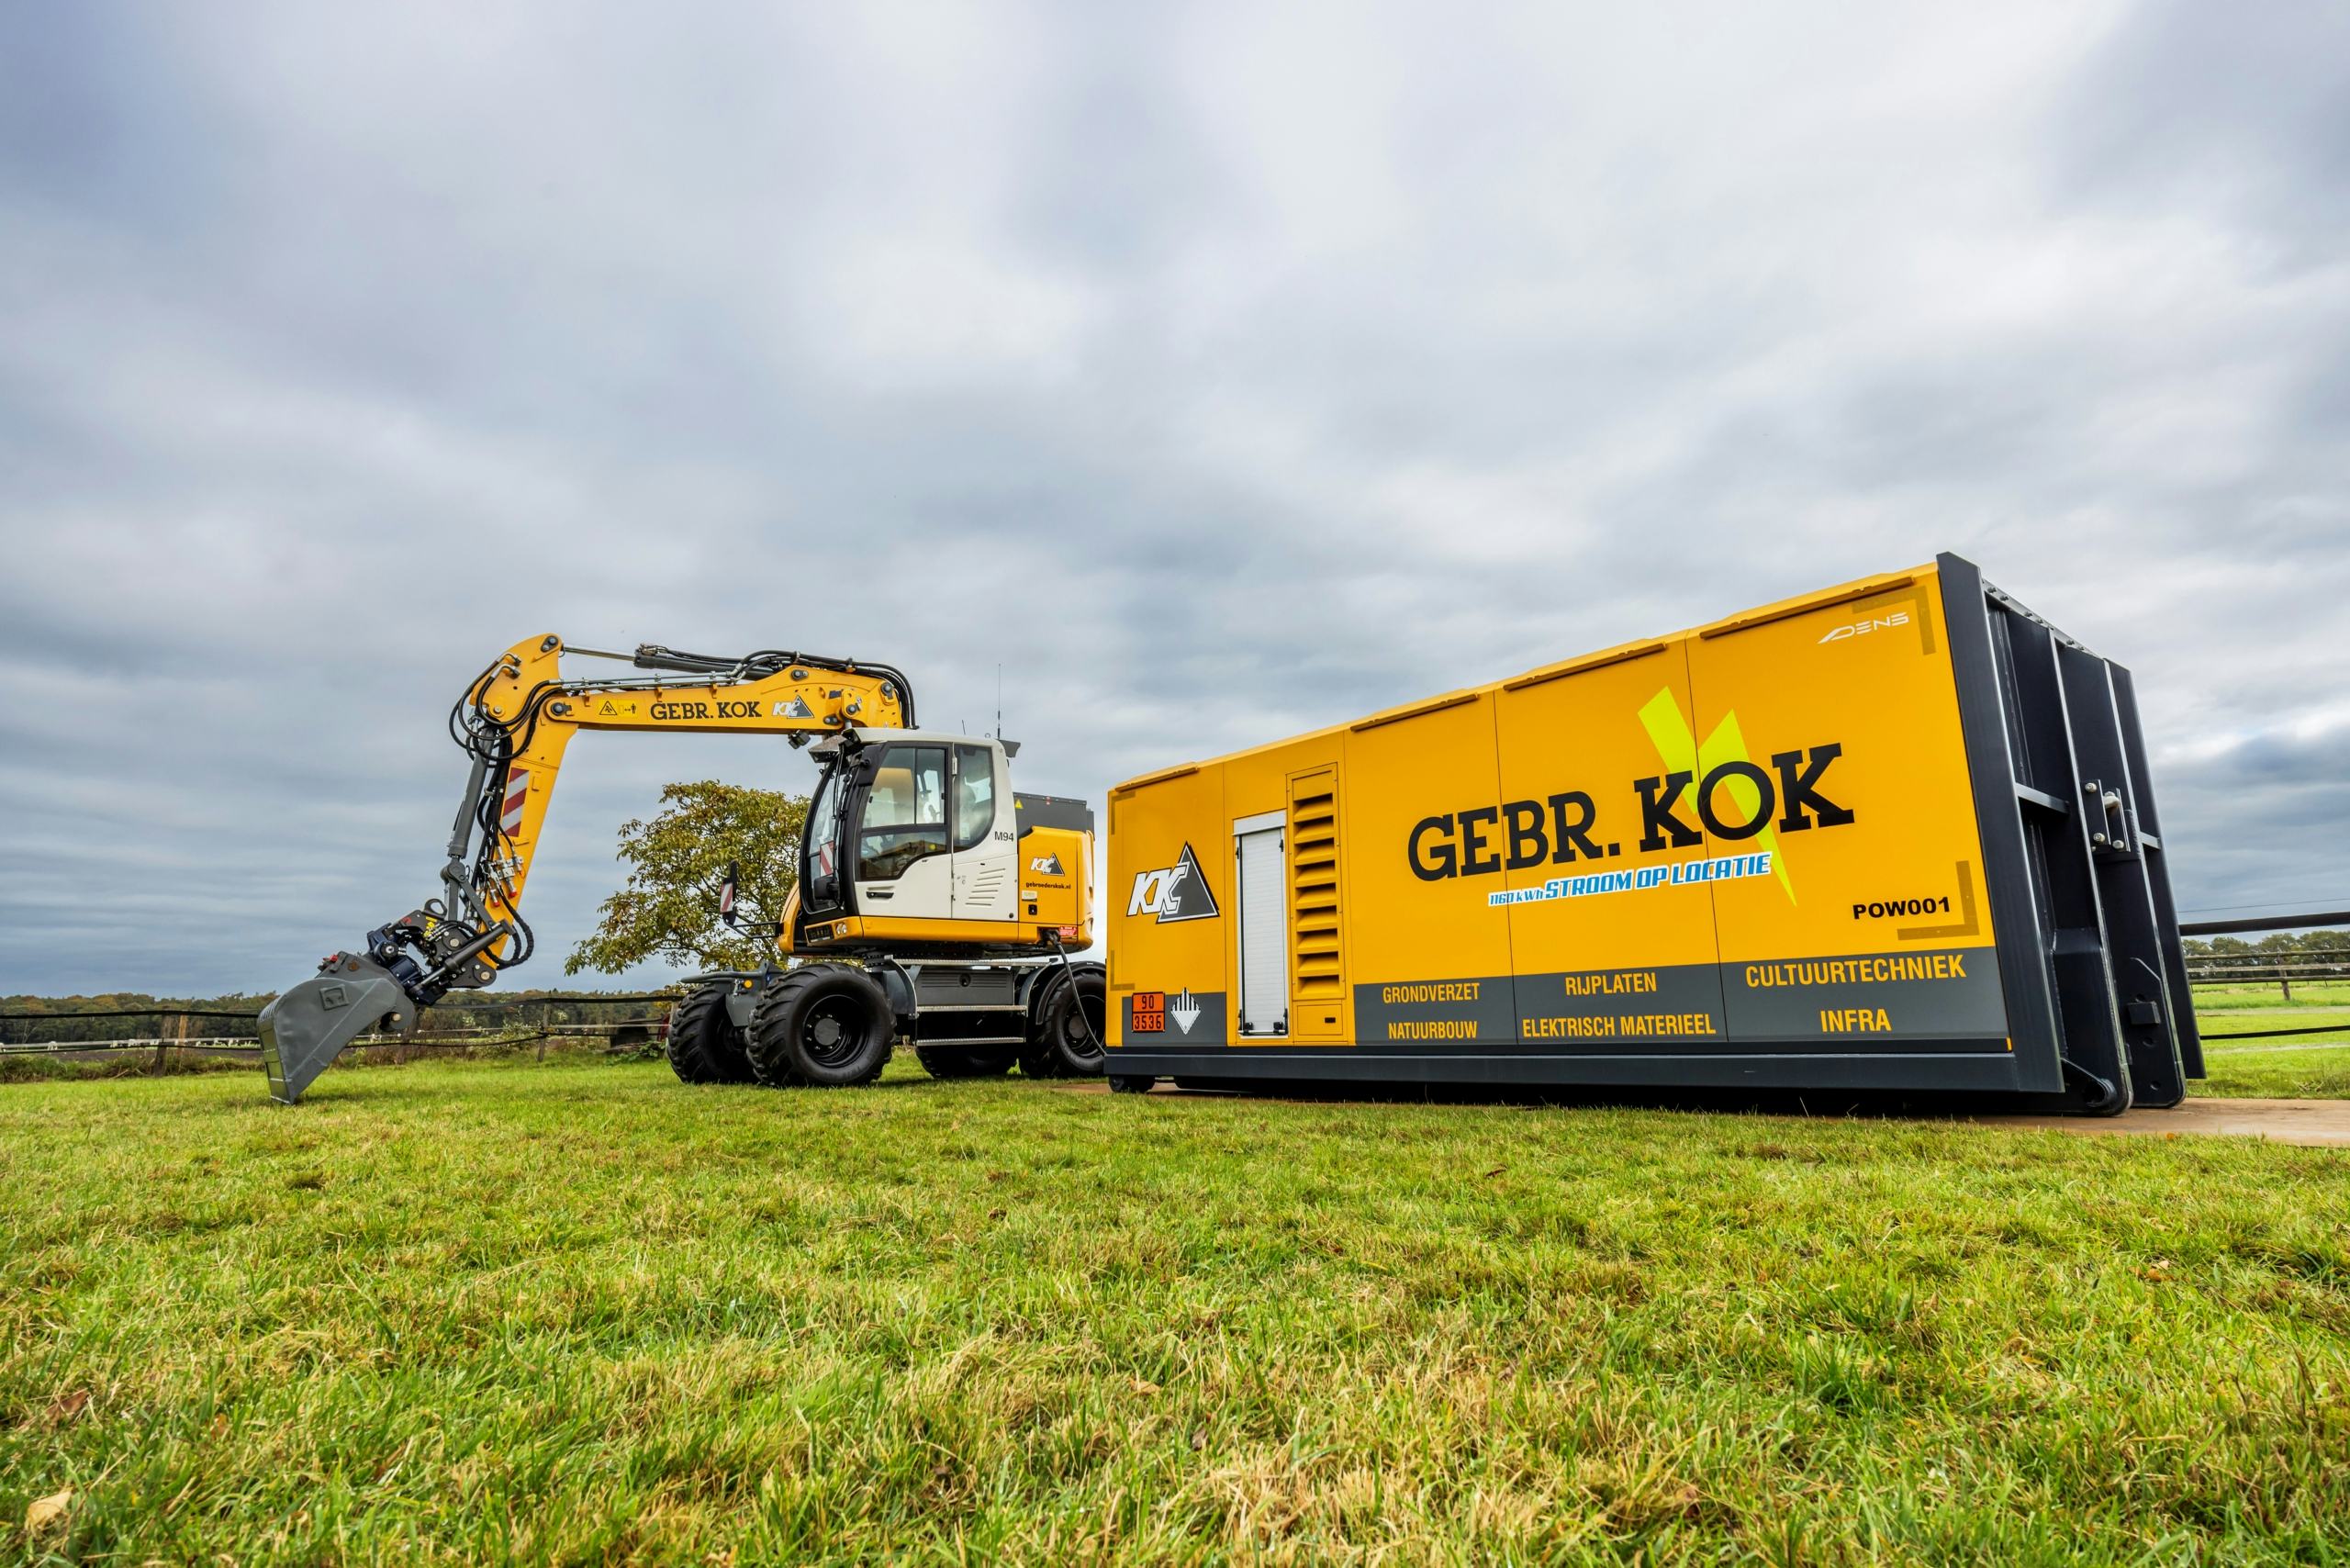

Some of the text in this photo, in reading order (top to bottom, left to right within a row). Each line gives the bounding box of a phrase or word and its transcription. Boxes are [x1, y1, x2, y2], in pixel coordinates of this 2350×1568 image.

[1817, 611, 1909, 644] DENS
[650, 700, 762, 720] GEBR. KOK
[1407, 742, 1855, 882] GEBR. KOK
[994, 831, 1014, 842] M94
[1490, 854, 1771, 905] 1160 kWh STROOM OP LOCATIE
[1852, 896, 1951, 920] POW001
[1746, 954, 1966, 988] CULTUURTECHNIEK
[1382, 982, 1480, 1004] GRONDVERZET
[1565, 972, 1657, 996] RIJPLATEN
[1141, 995, 1154, 1009] 90
[1134, 1015, 1161, 1029] 3536
[1388, 1021, 1477, 1040] NATUURBOUW
[1522, 1014, 1716, 1038] ELEKTRISCH MATERIEEL
[1820, 1008, 1891, 1033] INFRA
